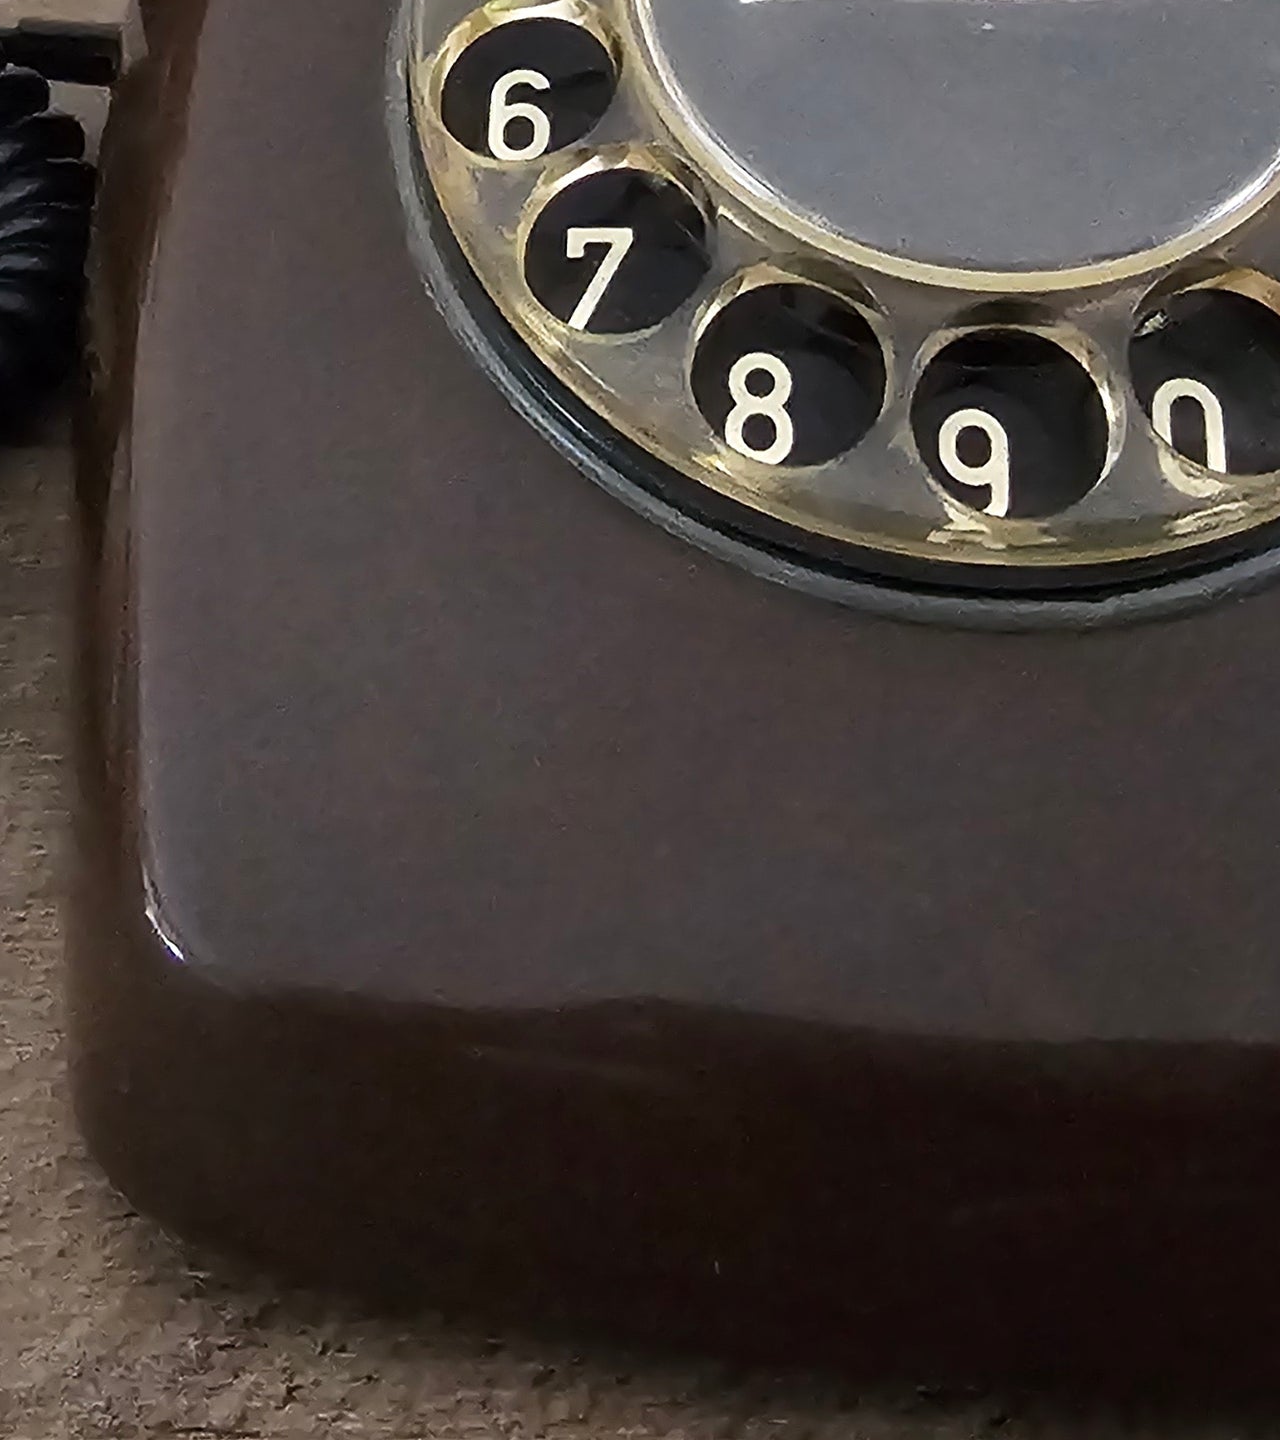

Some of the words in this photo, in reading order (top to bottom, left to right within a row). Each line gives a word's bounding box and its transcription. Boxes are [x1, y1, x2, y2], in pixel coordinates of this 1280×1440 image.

[487, 69, 551, 162] 6
[566, 227, 634, 331] 7
[724, 351, 794, 465] 8
[938, 408, 1010, 519] 9
